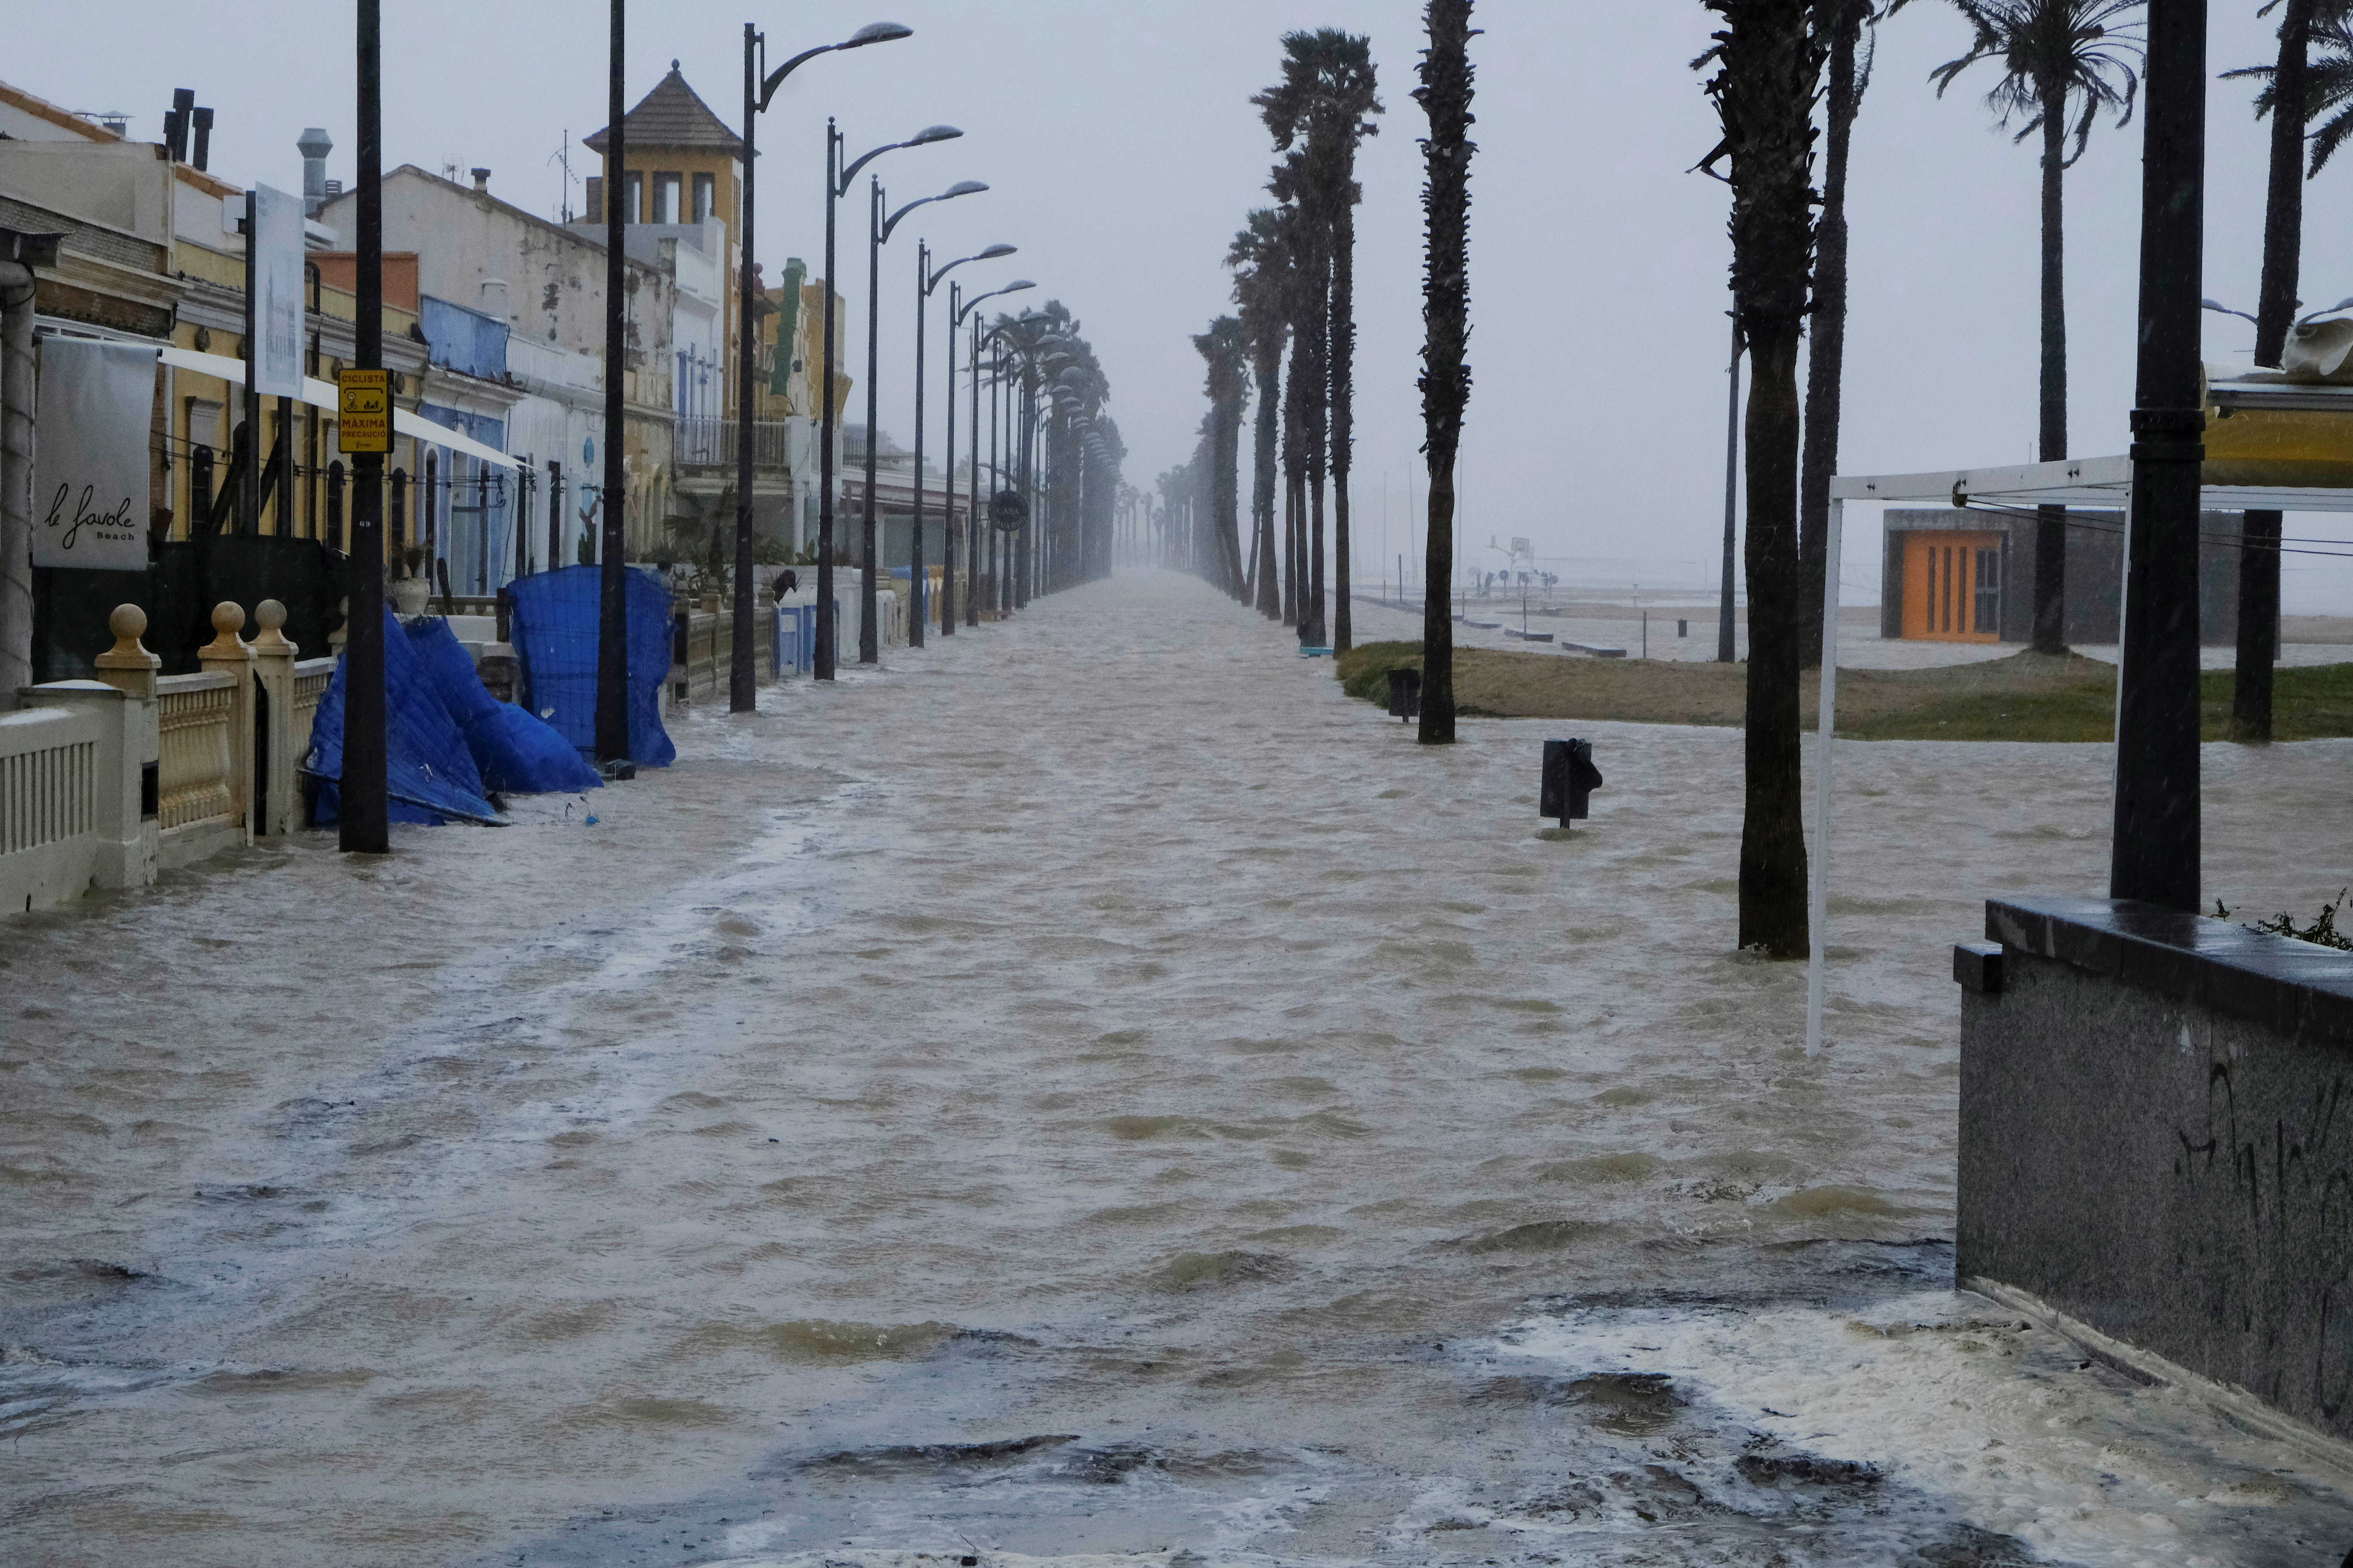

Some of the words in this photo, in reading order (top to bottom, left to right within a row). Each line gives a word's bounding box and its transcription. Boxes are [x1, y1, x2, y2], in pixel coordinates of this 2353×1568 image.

[342, 417, 385, 429] MÀXIMA
[62, 484, 135, 549] favole
[995, 516, 1026, 529] VARRO
[97, 531, 134, 540] Beach
